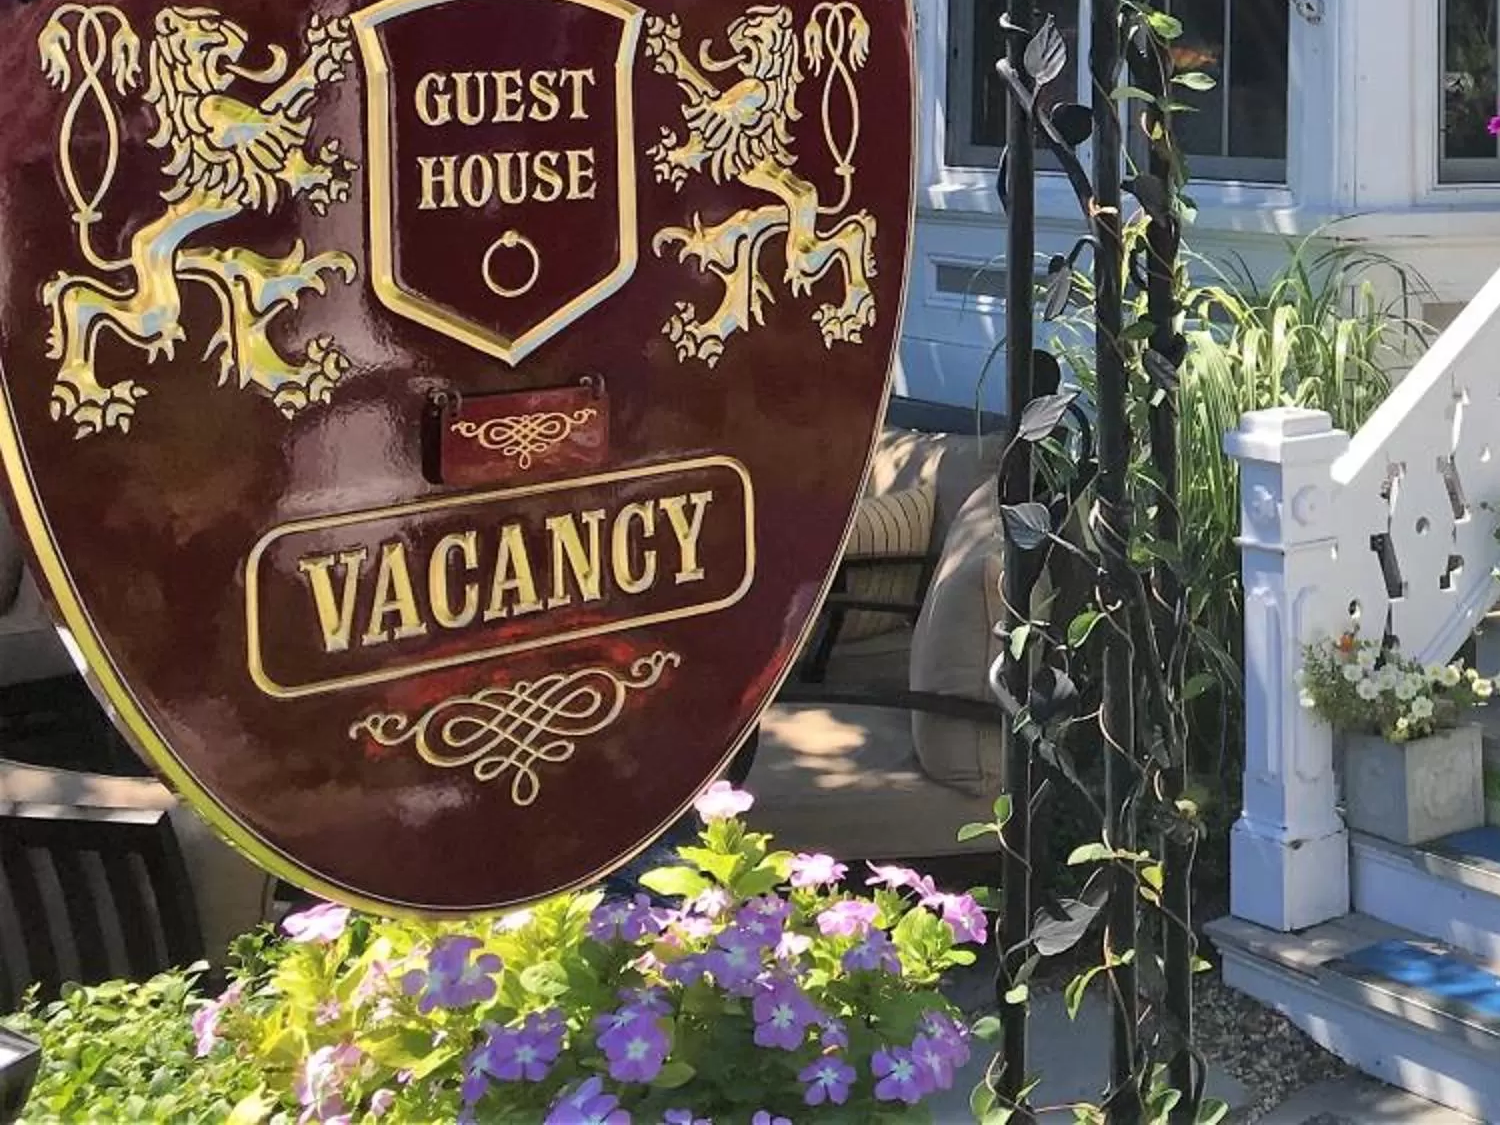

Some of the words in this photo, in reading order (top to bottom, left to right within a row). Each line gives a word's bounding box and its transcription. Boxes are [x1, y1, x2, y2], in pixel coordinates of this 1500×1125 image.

[415, 69, 596, 128] GUEST
[416, 147, 597, 210] HOUSE
[299, 490, 713, 653] VACANCY
